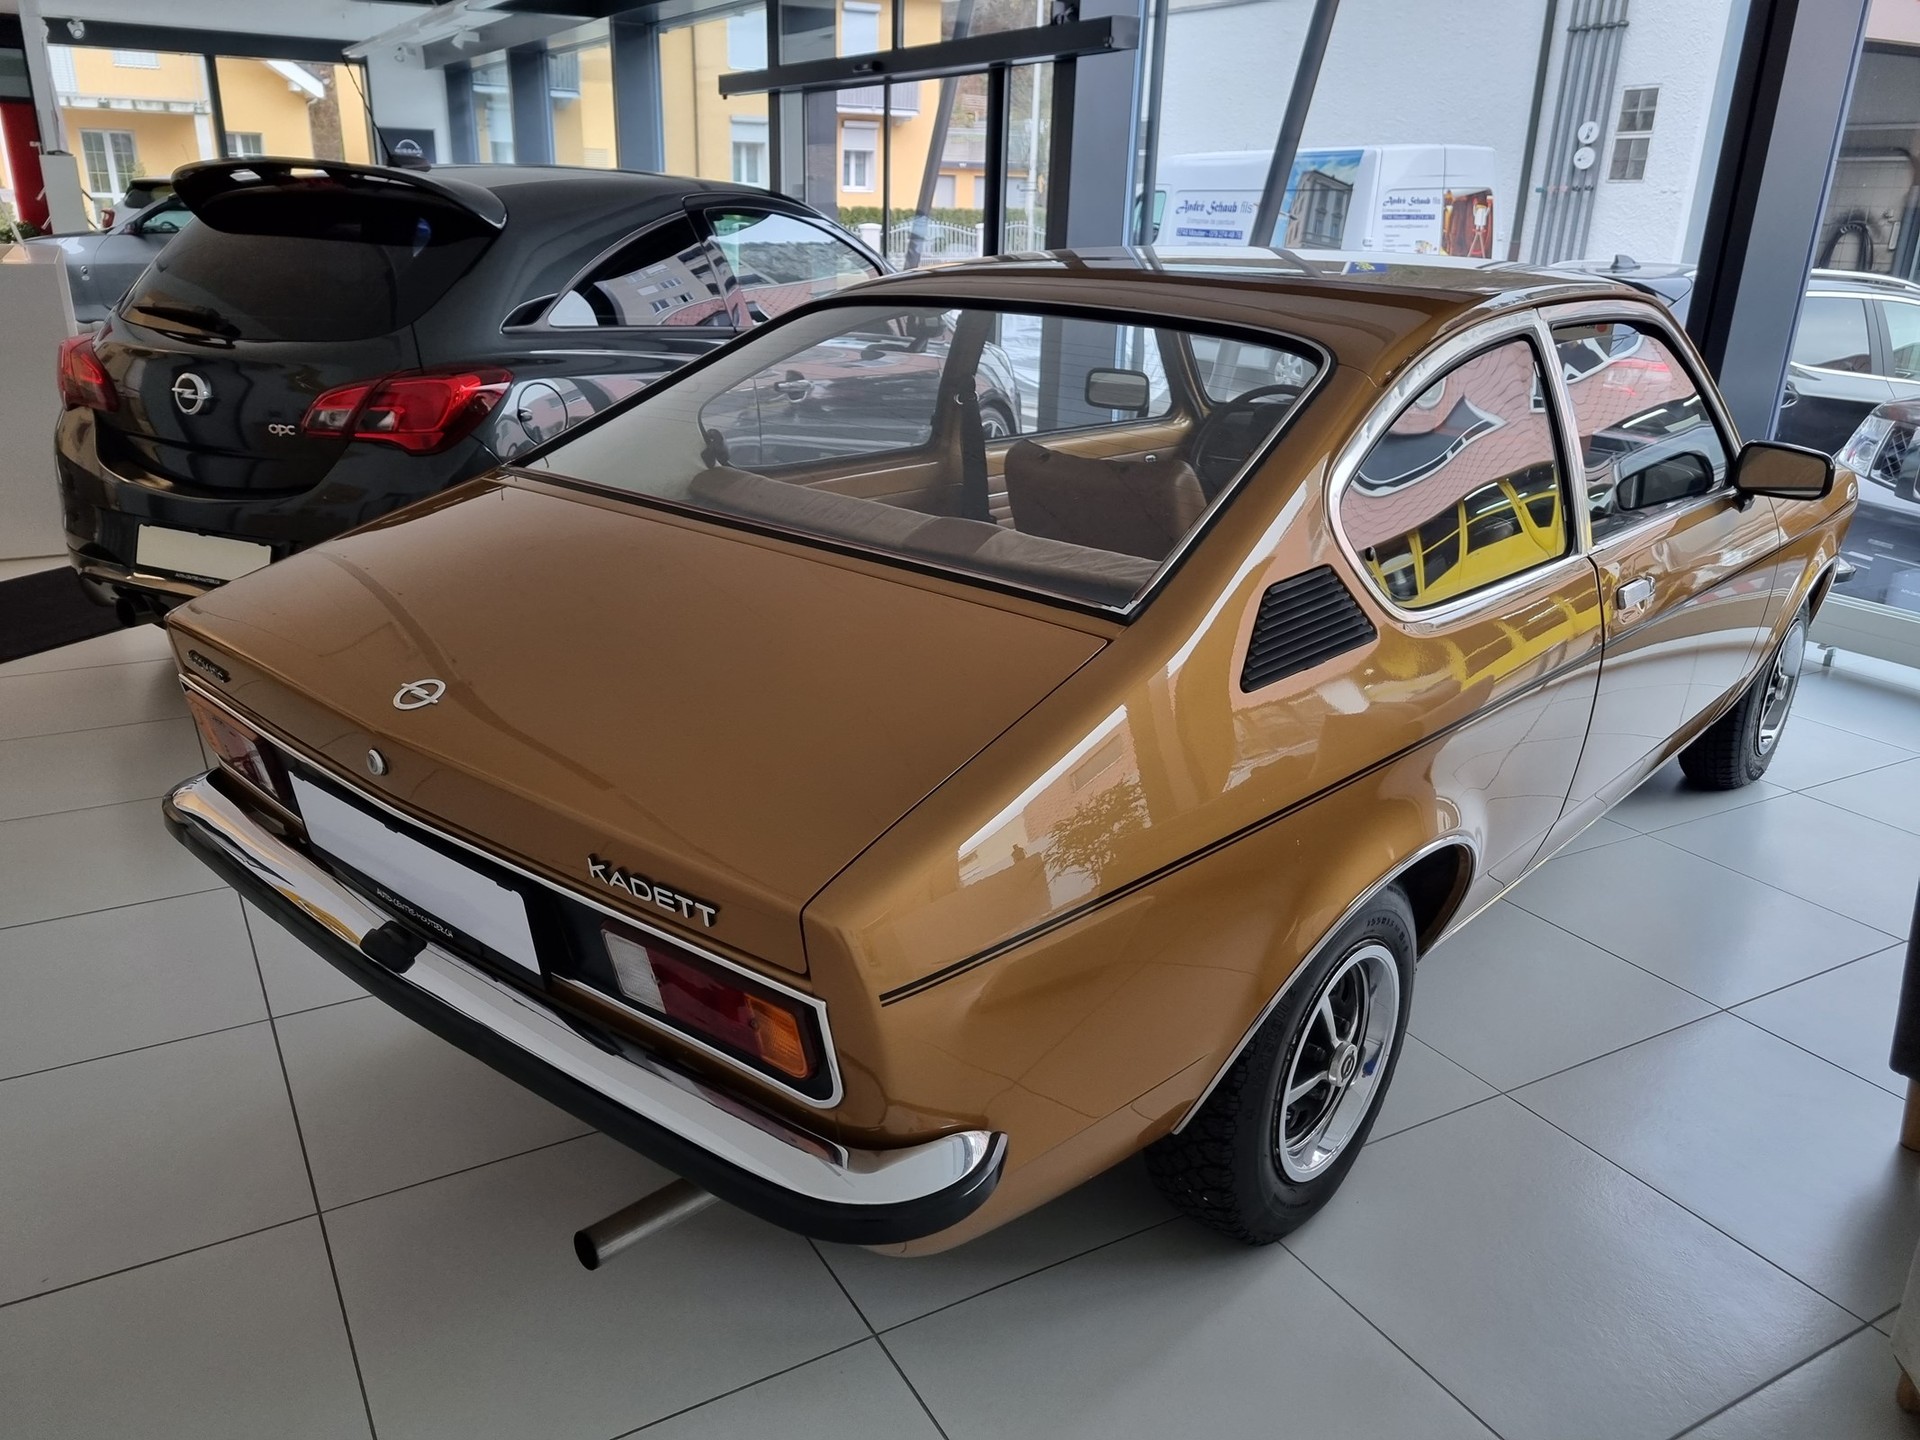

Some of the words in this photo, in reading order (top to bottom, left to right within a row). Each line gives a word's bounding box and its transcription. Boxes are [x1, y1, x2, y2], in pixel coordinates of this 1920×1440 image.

[1176, 200, 1205, 214] André
[1206, 200, 1238, 215] Schaub
[586, 856, 717, 928] KADETT
